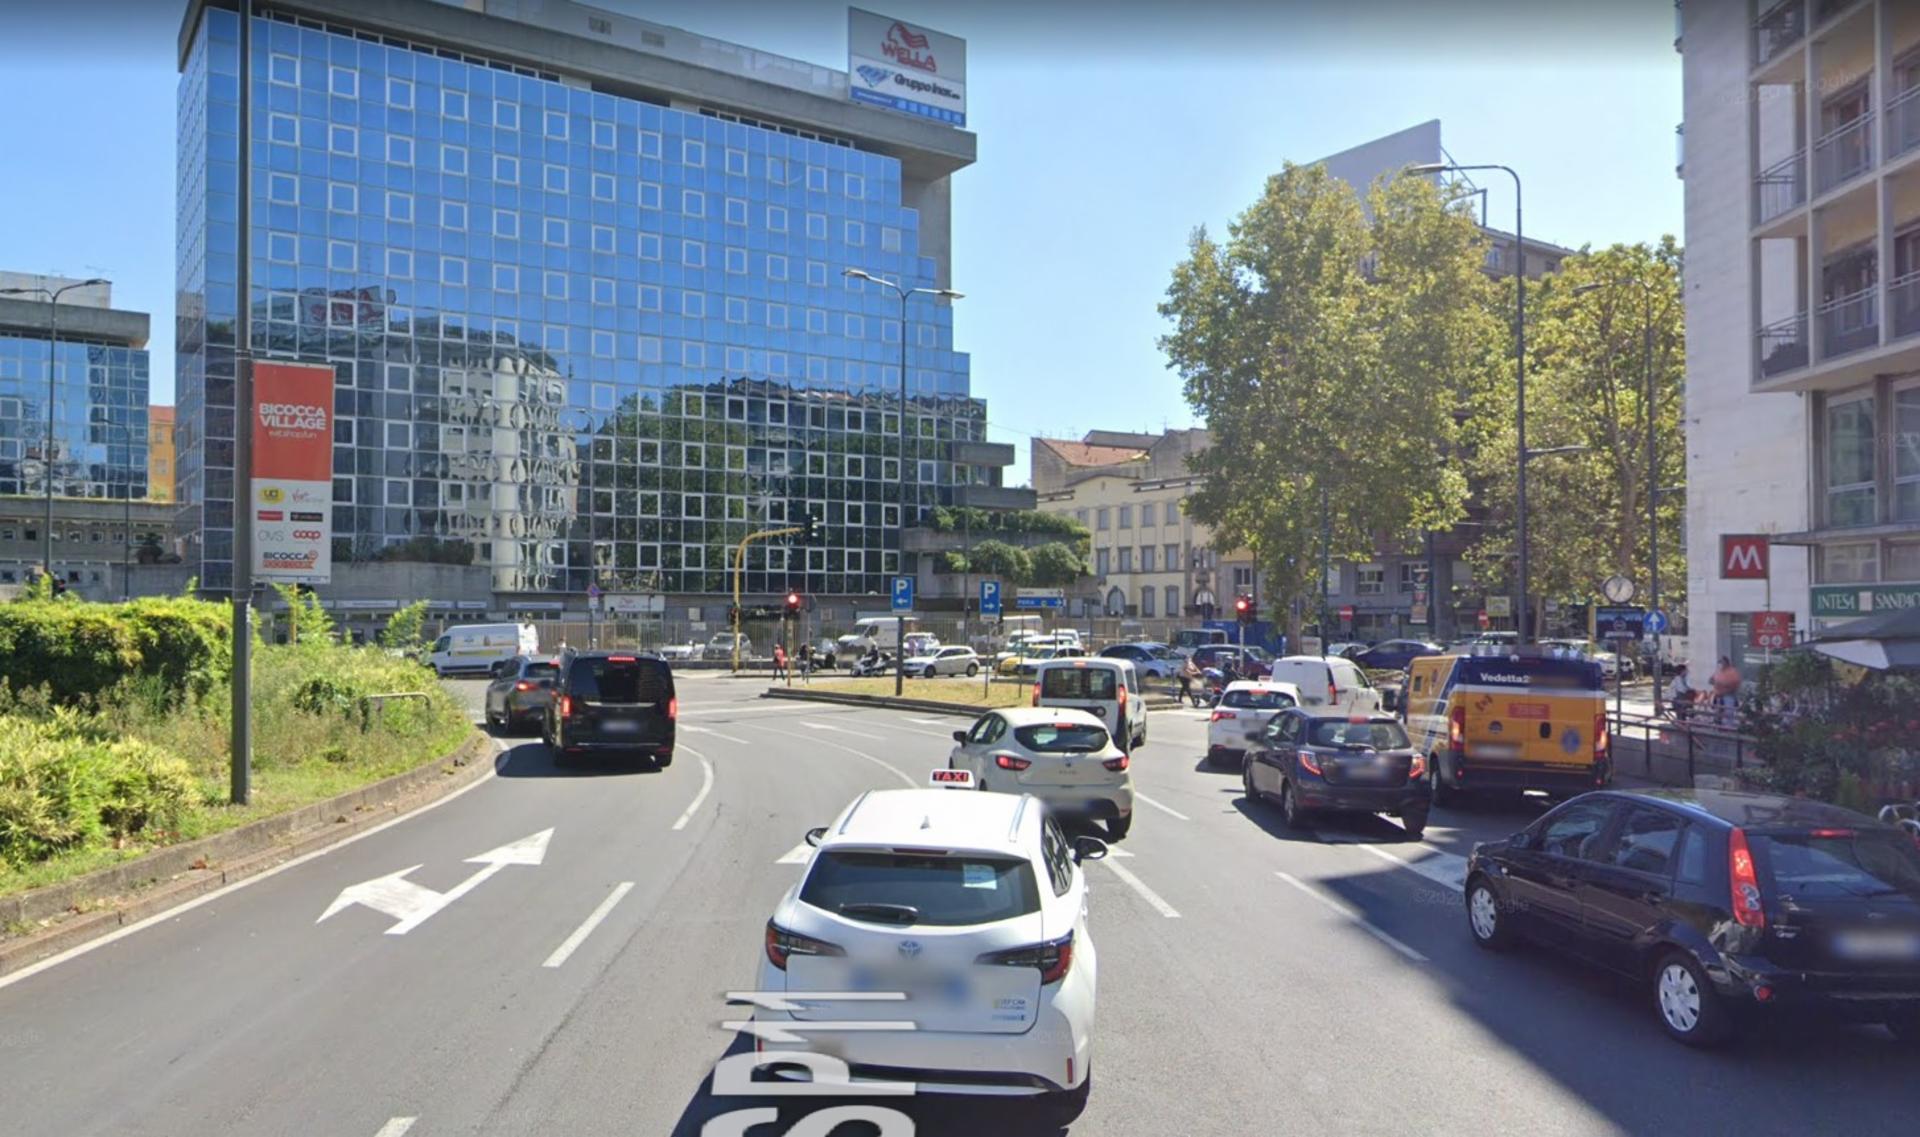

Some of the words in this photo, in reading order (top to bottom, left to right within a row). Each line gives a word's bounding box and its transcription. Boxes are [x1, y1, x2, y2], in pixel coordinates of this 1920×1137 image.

[881, 41, 937, 73] WELLA
[894, 72, 931, 92] Gruppo
[259, 403, 326, 418] BICOCCA
[260, 415, 327, 430] VILLAGE
[257, 530, 285, 542] OVS
[292, 530, 322, 541] coop
[263, 551, 310, 560] BICOCCA
[1727, 545, 1763, 570] M
[896, 579, 908, 595] P
[984, 583, 996, 599] P
[1817, 593, 1856, 609] INTESA
[935, 771, 968, 782] TAXI
